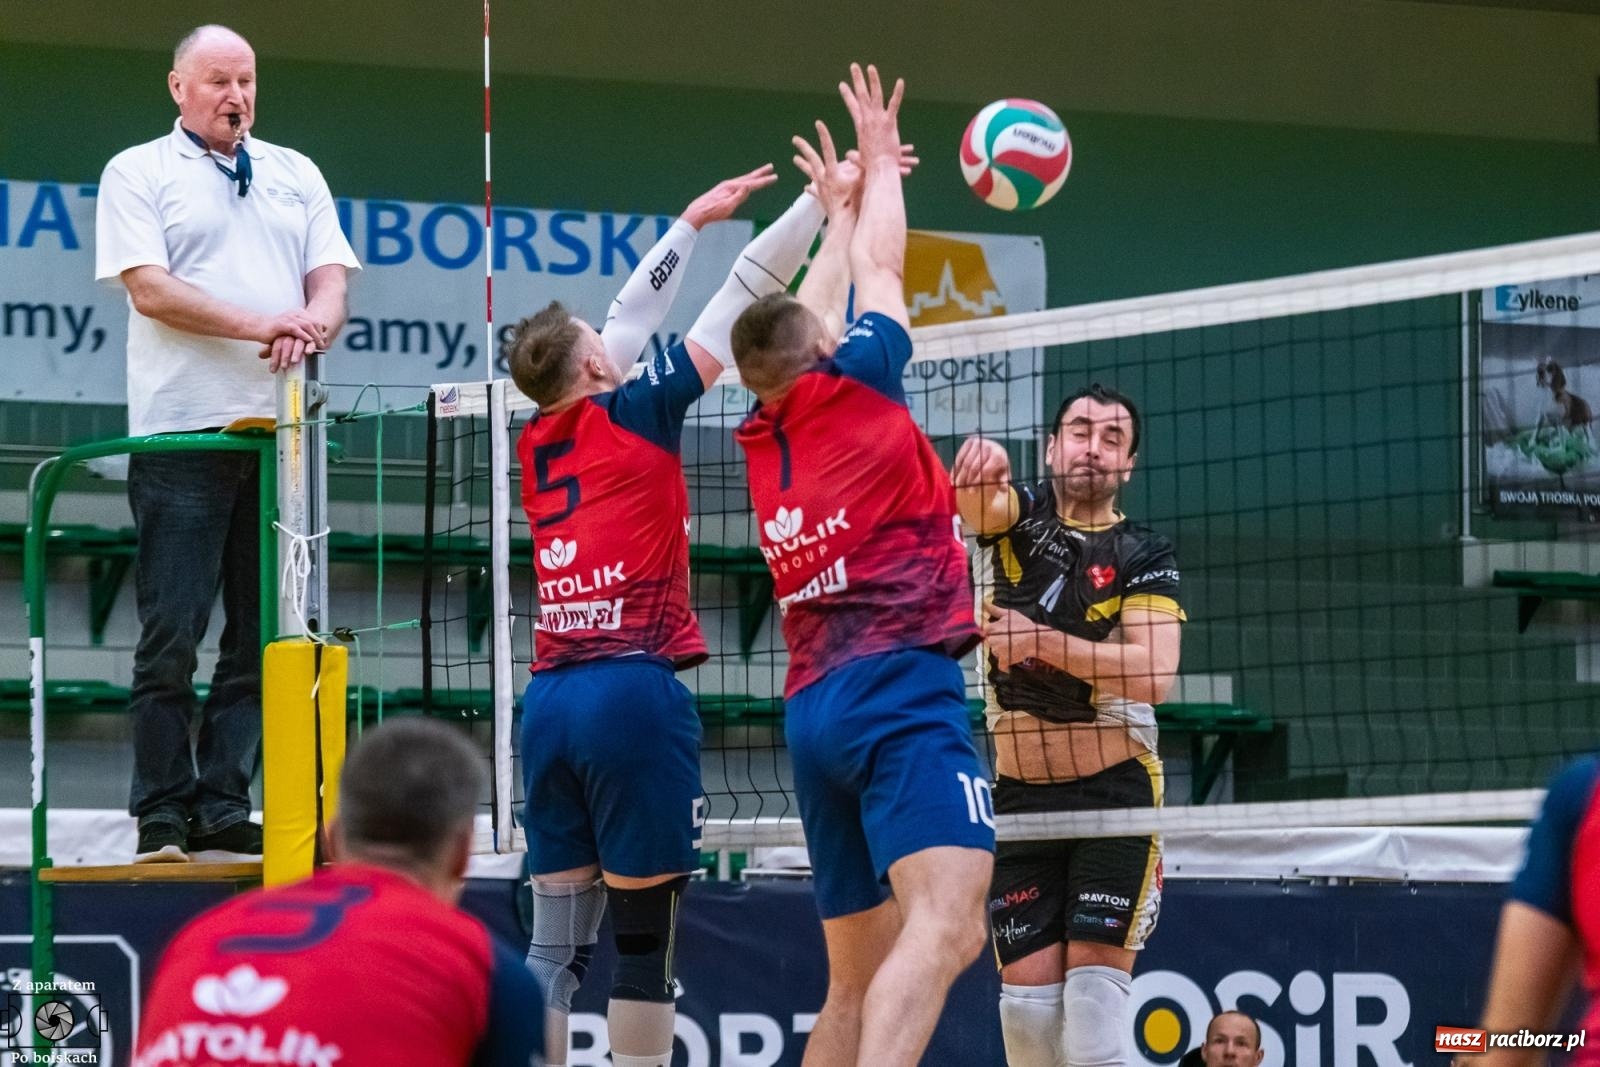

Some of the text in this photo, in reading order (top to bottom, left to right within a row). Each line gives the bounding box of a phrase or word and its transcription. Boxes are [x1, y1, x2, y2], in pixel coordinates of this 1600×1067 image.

[903, 352, 1012, 384] iborski
[533, 437, 582, 529] 5
[957, 771, 995, 831] 10
